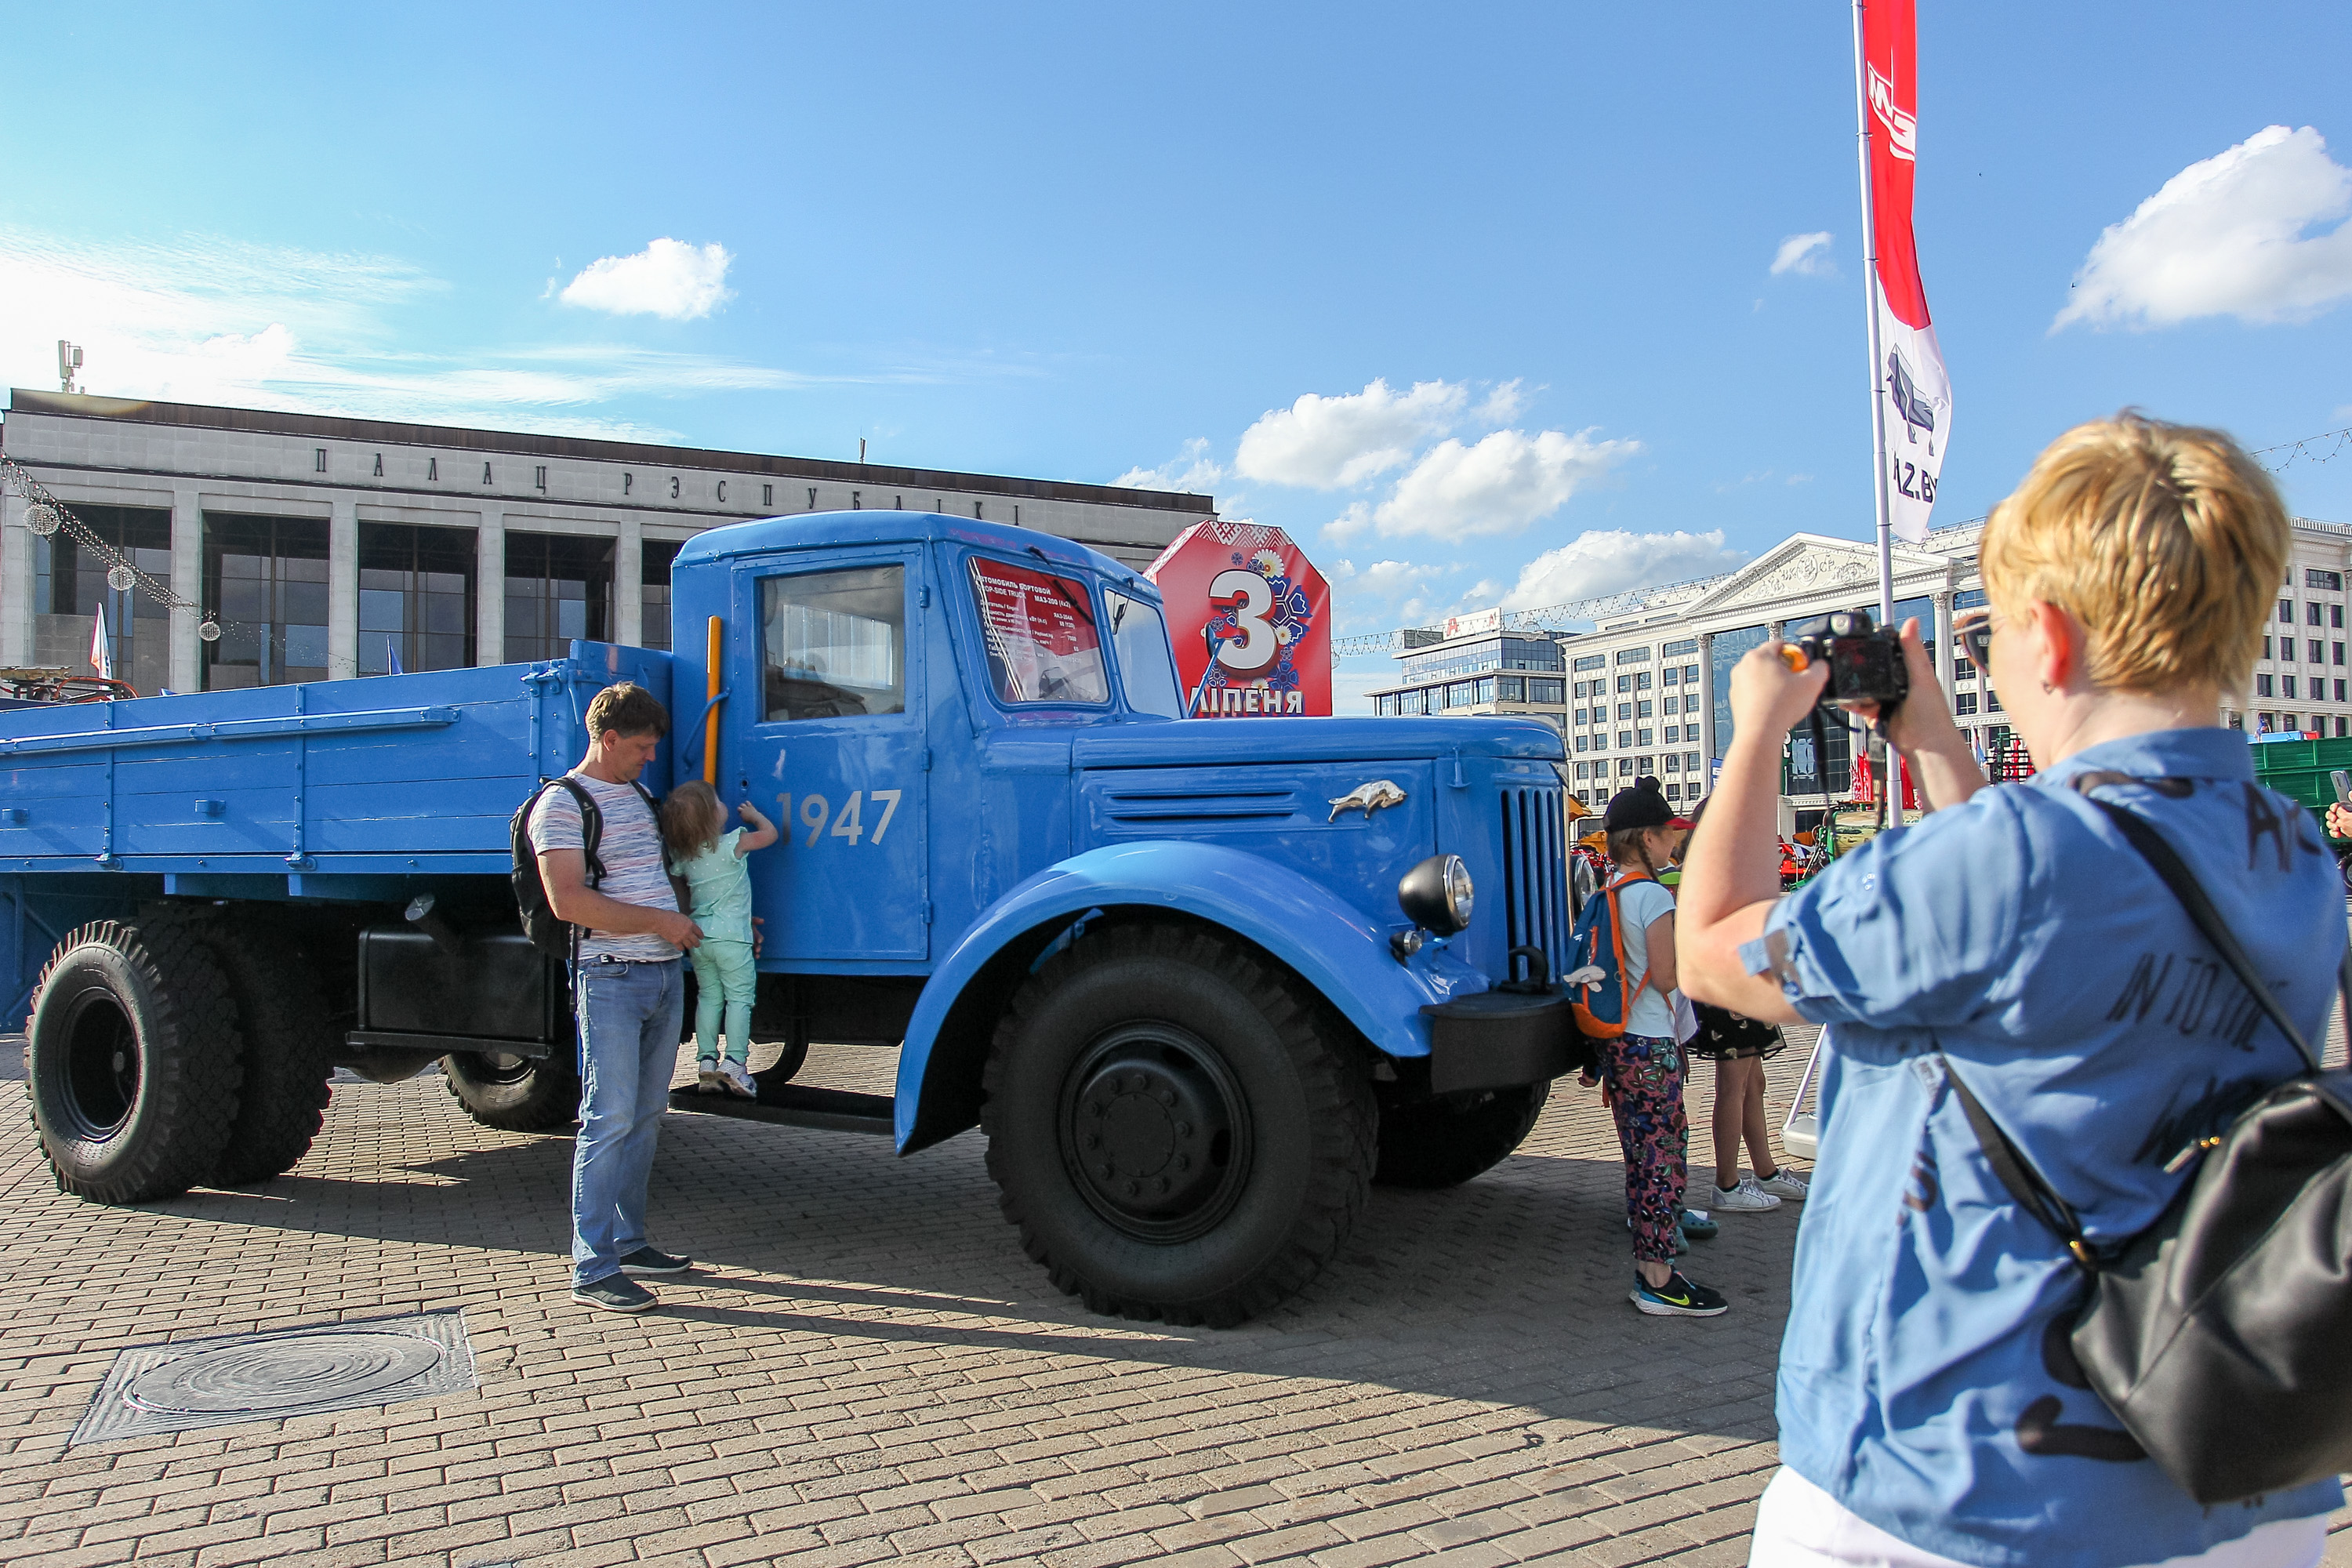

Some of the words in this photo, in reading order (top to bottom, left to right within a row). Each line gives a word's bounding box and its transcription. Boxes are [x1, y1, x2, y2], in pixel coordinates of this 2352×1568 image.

[316, 448, 546, 495] ПАЛАЦ
[624, 472, 1019, 526] РЭСПУБЛІКІ
[977, 584, 1007, 596] DOP-SIDE
[1007, 590, 1027, 599] TRUCK
[1019, 583, 1051, 595] БОРТОВОЙ
[1208, 569, 1278, 670] 3
[1189, 687, 1303, 714] ЛІПЕНЯ
[776, 789, 902, 848] 1947
